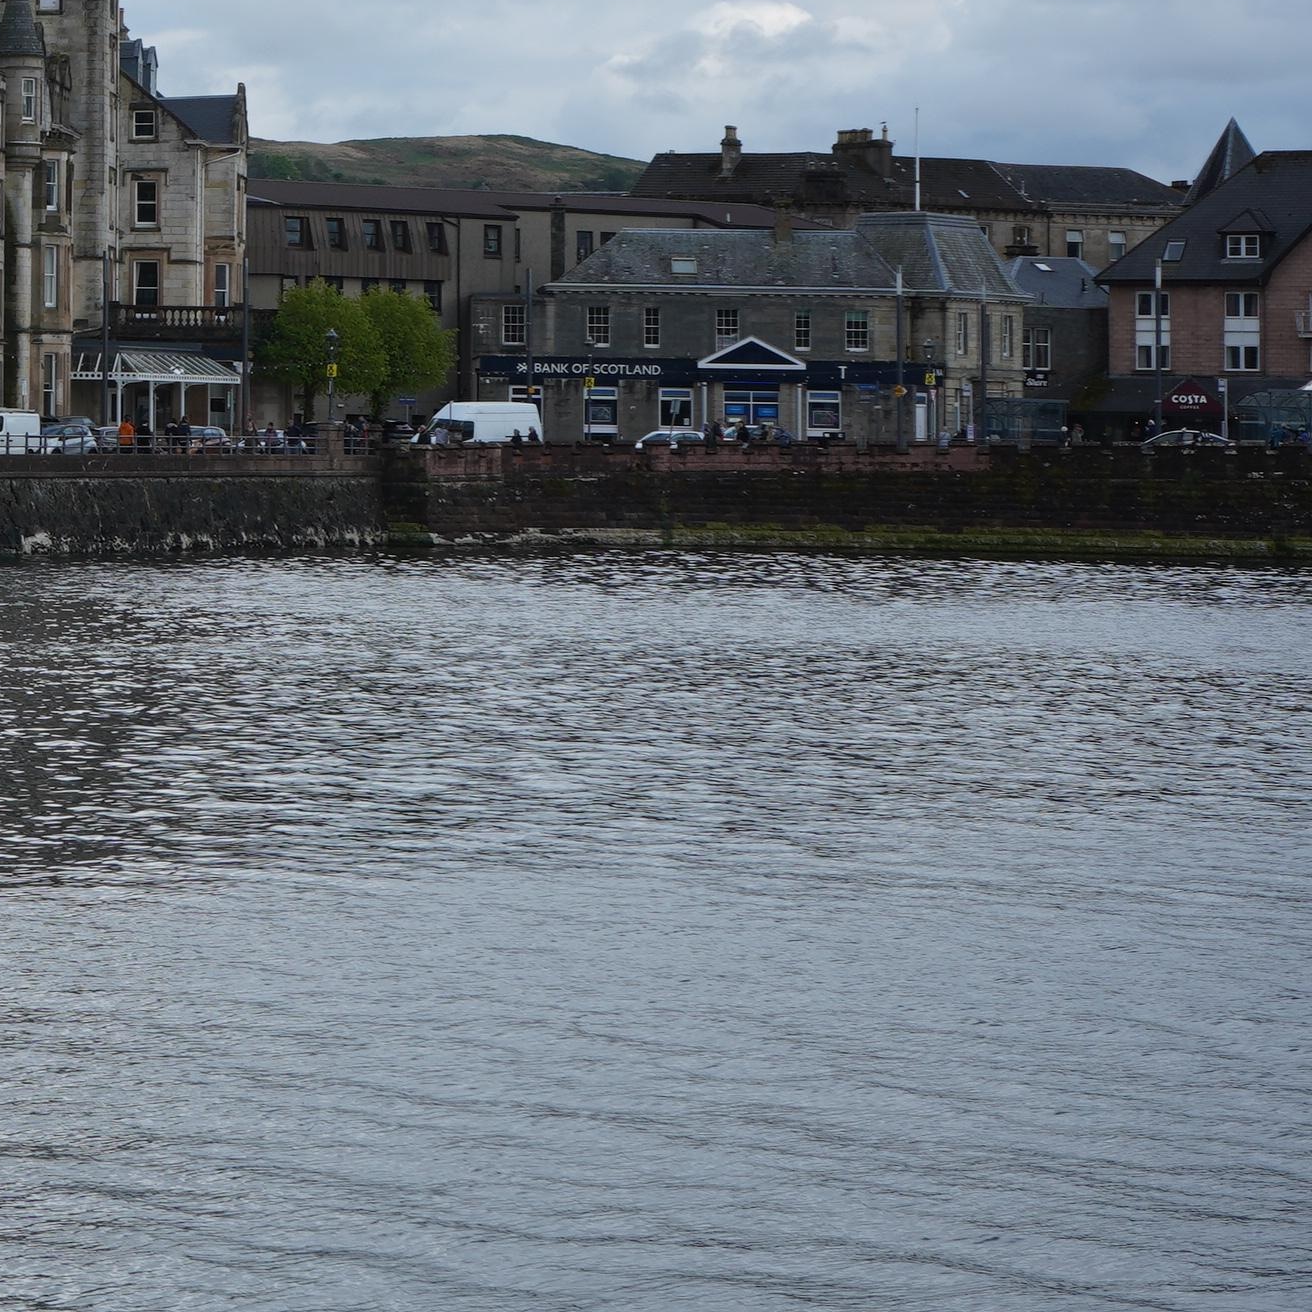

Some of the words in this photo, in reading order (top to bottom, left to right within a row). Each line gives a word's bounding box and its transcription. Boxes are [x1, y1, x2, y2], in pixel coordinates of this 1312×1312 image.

[534, 363, 568, 374] BANK
[572, 364, 589, 374] OF
[593, 364, 662, 375] SCOTLAND
[1171, 395, 1208, 404] COSTA
